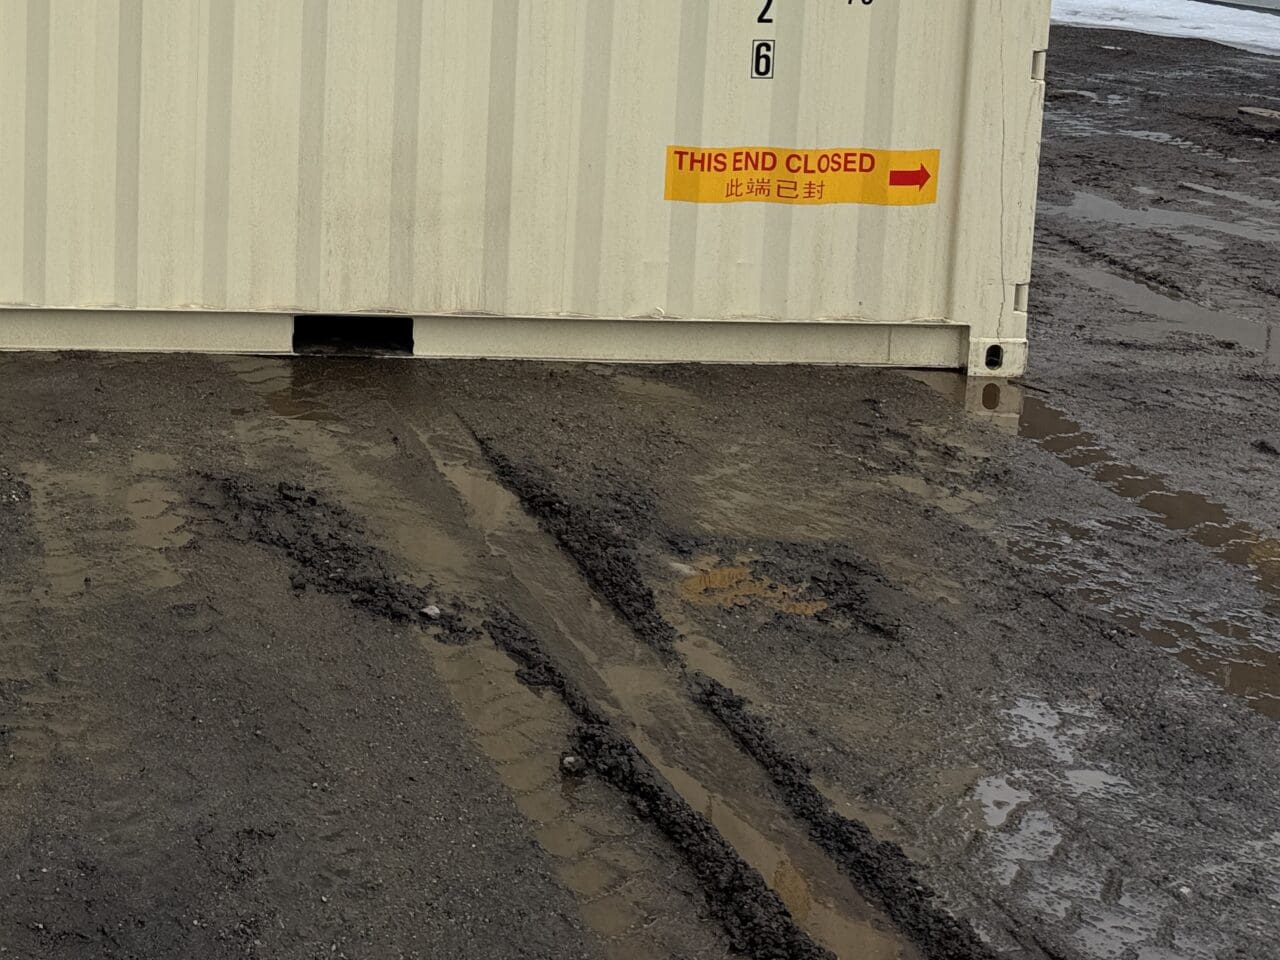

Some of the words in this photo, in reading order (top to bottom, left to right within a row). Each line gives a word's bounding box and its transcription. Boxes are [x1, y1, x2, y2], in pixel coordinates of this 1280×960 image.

[754, 42, 771, 76] 6
[673, 151, 728, 173] THIS
[732, 151, 777, 172] END
[785, 152, 876, 174] CLOSED
[725, 177, 826, 200] 此端已封
